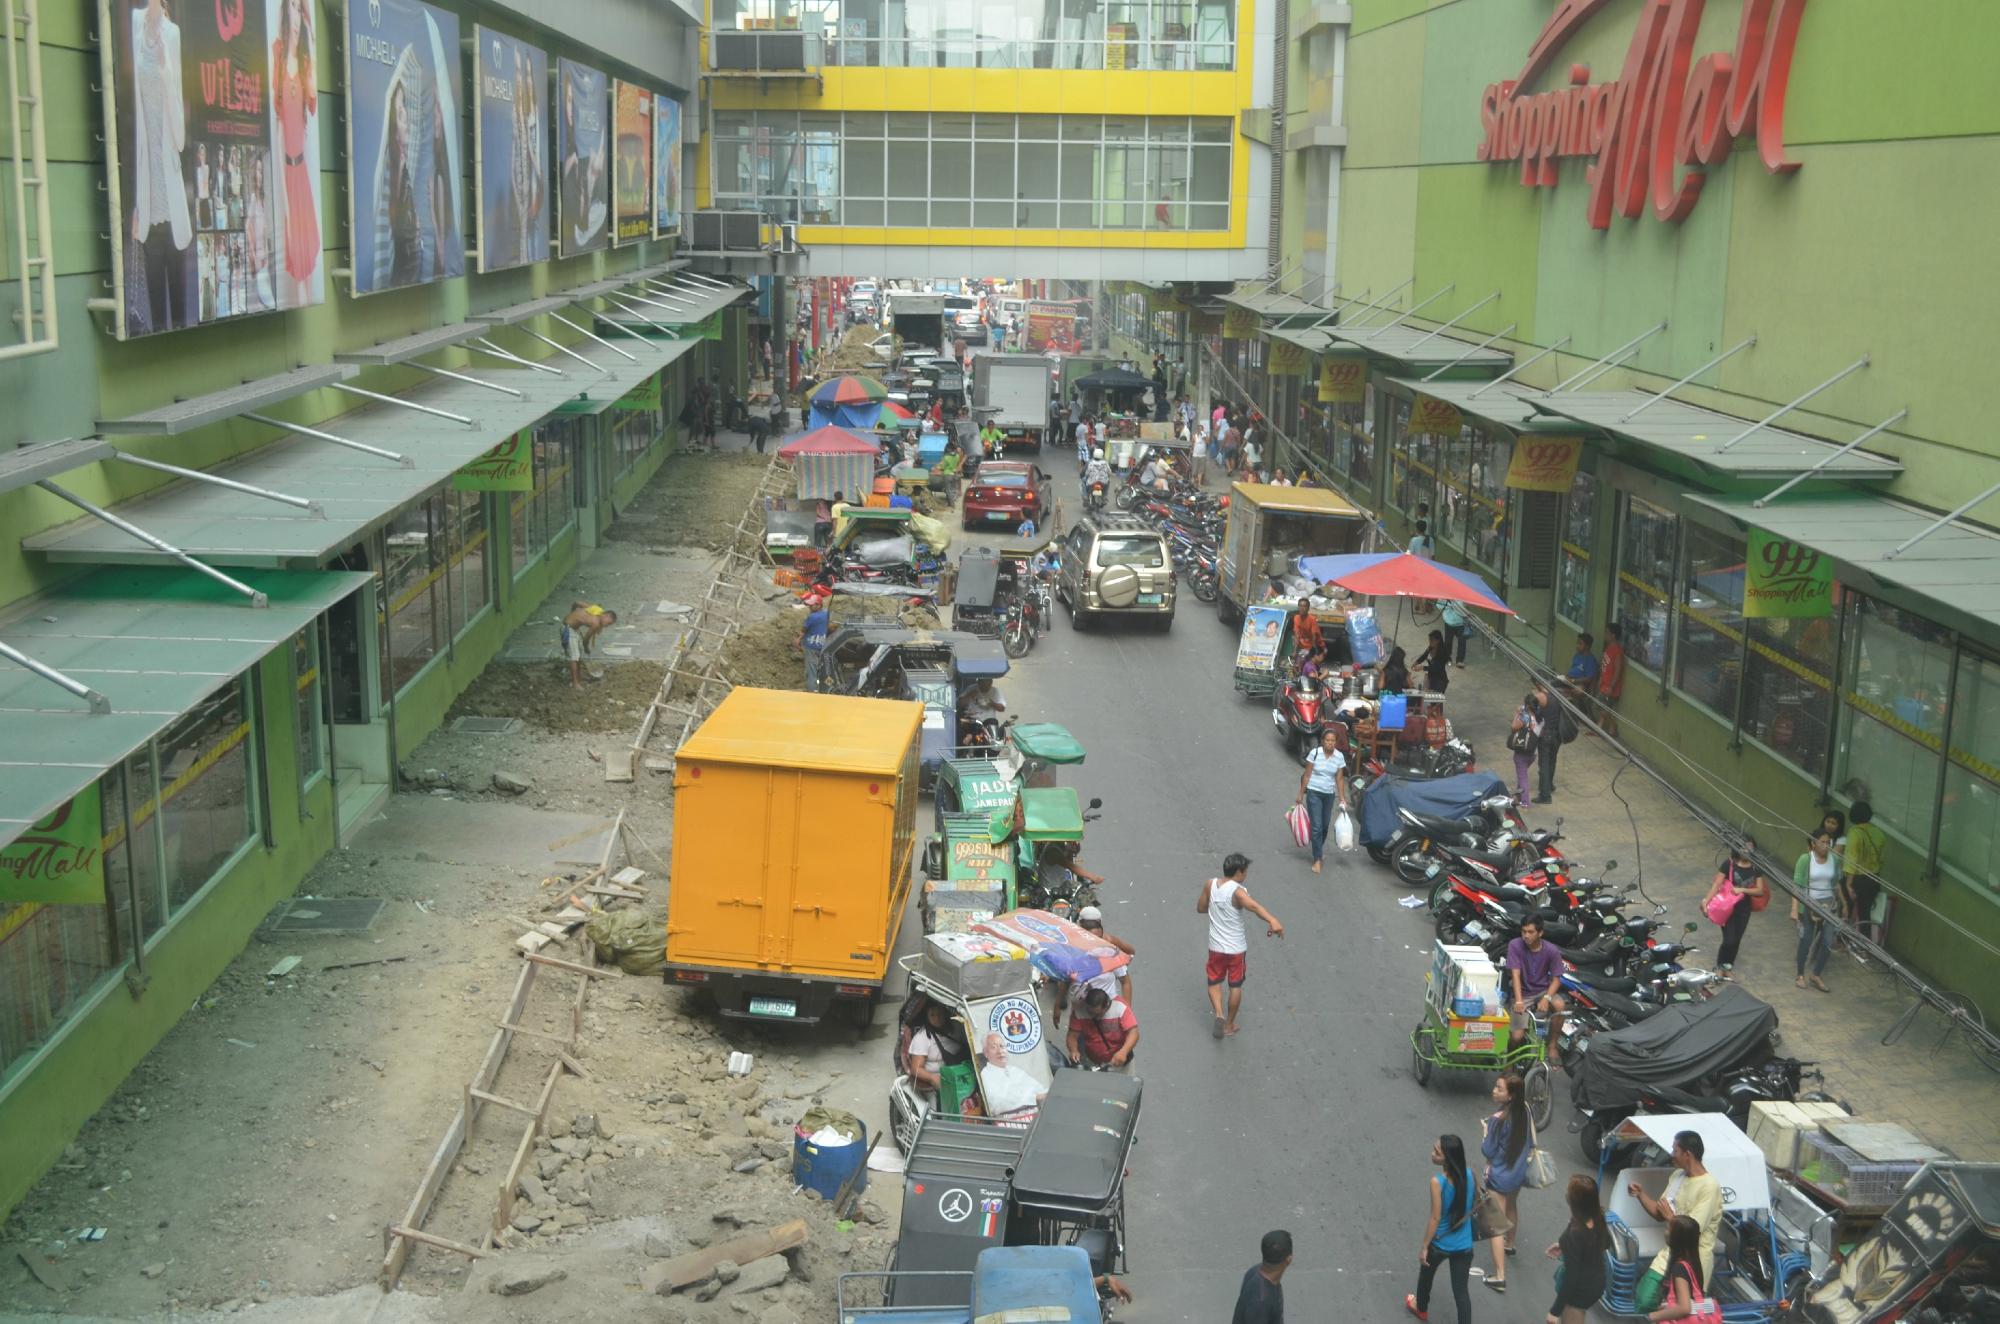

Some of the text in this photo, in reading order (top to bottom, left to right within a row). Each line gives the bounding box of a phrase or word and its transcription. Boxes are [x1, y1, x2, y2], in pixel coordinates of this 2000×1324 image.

[1477, 0, 1803, 230] Shopping Mall
[1329, 363, 1360, 382] 999
[1528, 443, 1572, 465] 999
[1760, 541, 1819, 578] 999
[1785, 580, 1829, 603] Mall
[16, 846, 97, 880] Mall
